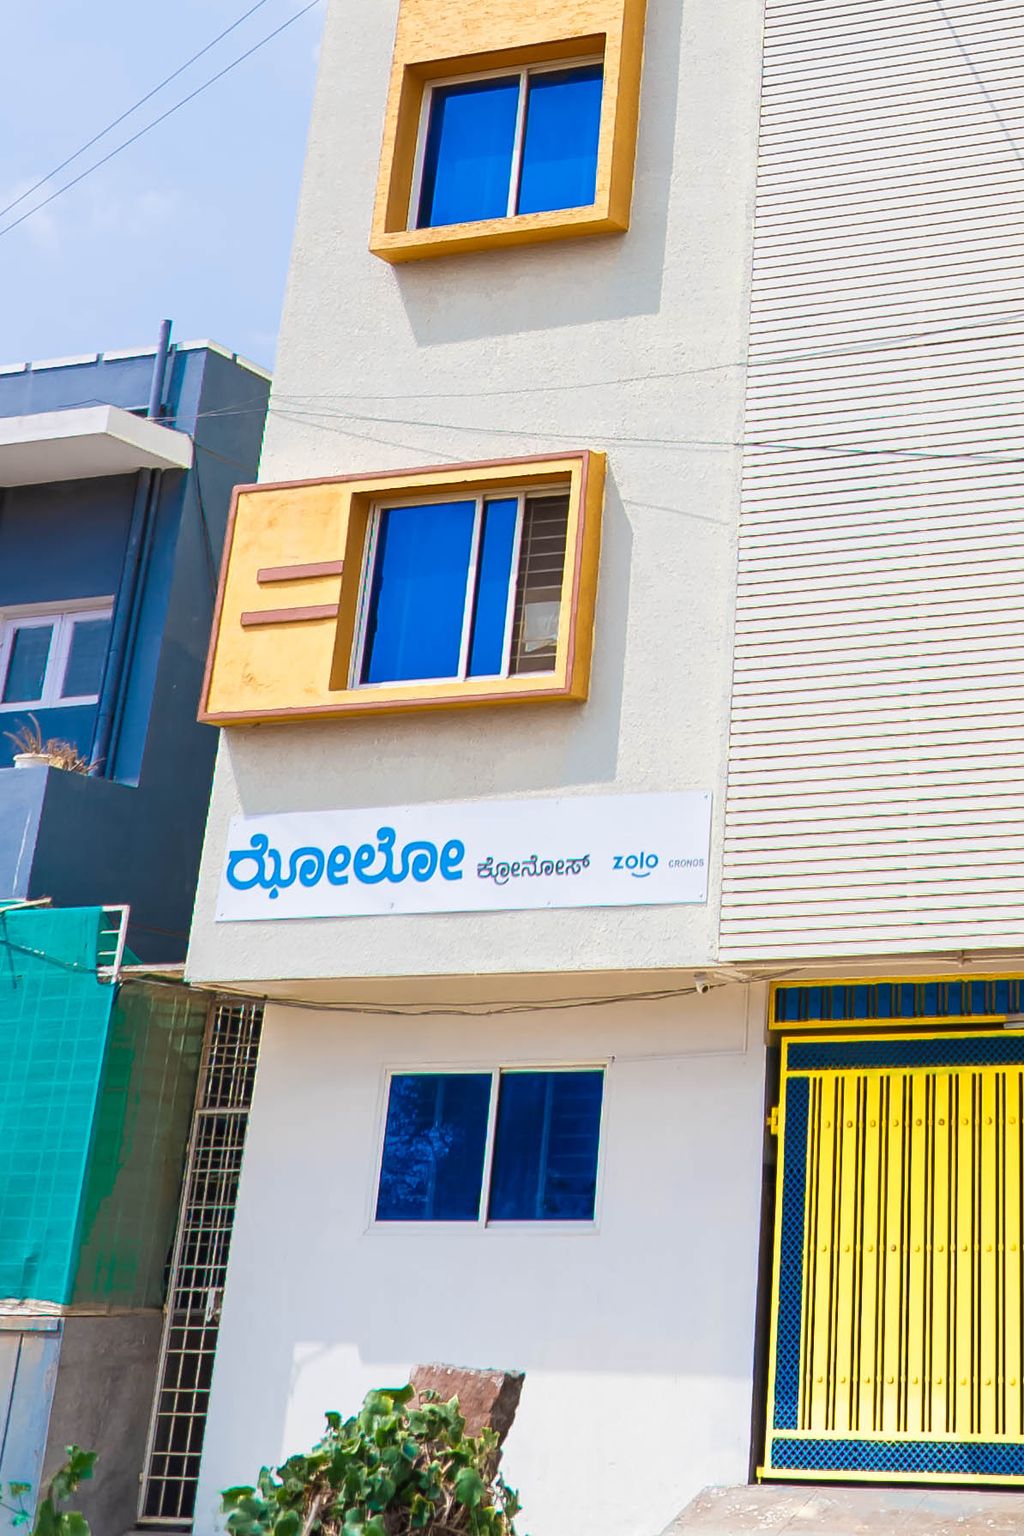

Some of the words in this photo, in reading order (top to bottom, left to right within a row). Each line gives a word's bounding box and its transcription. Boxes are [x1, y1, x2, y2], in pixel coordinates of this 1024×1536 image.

[226, 826, 465, 899] ಝೋಲೋ
[477, 854, 590, 885] ಕ್ರೋನೋಸ್
[612, 851, 659, 870] zolo
[668, 858, 705, 869] CRONOS
